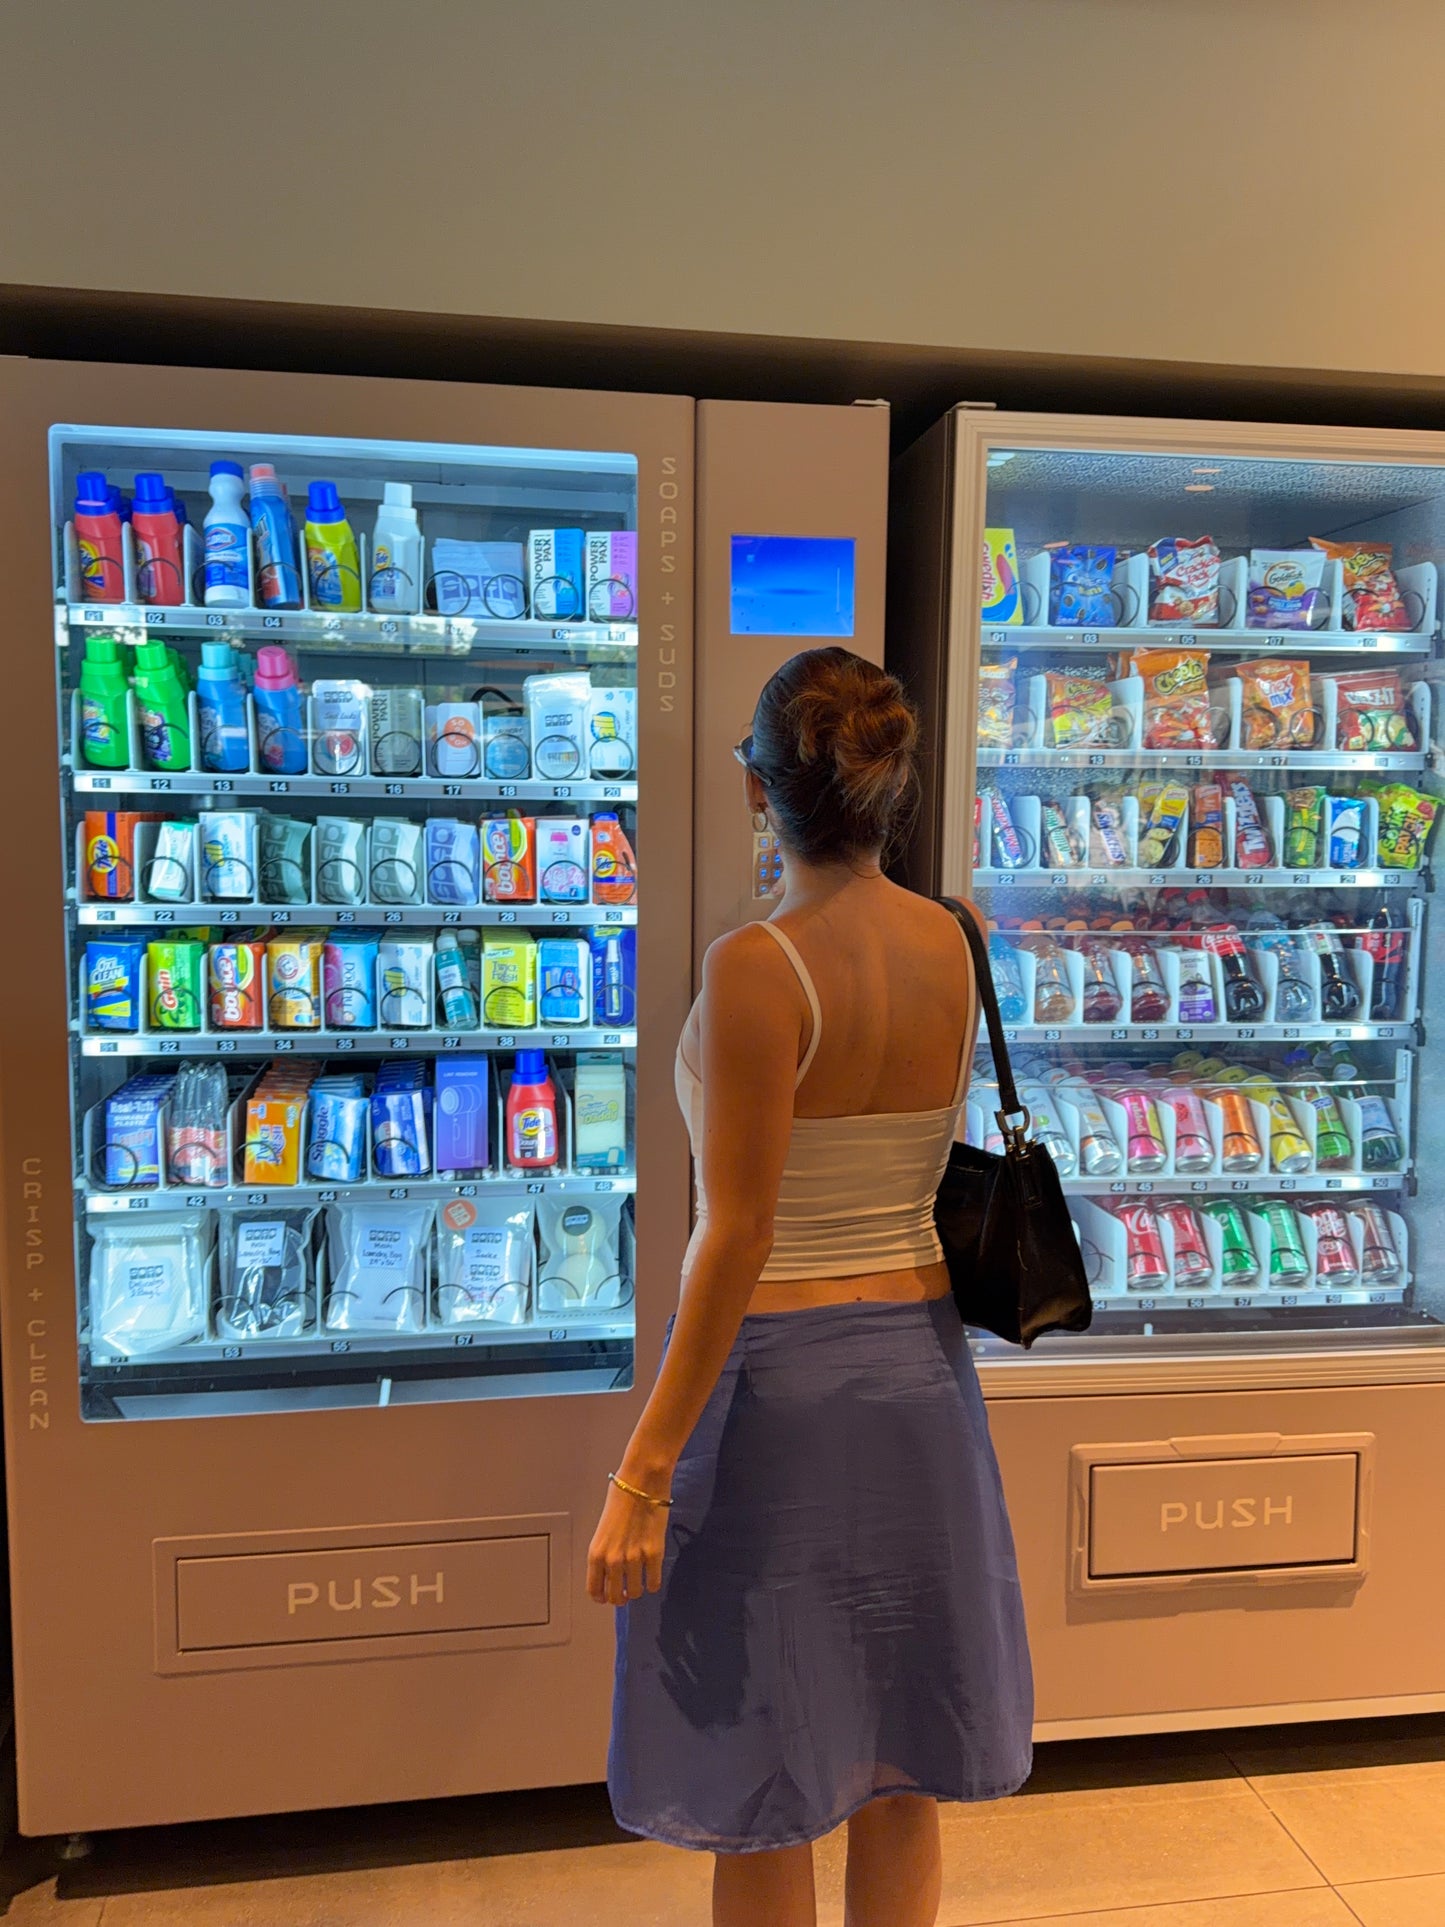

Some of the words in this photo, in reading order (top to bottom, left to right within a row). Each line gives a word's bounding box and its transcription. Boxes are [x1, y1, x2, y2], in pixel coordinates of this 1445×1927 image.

[659, 457, 678, 573] SOAPS
[543, 539, 551, 561] PAX
[599, 540, 607, 563] PAX
[534, 538, 543, 582] POWER
[590, 540, 598, 582] POWER
[661, 591, 674, 605] +
[147, 613, 162, 623] 02
[208, 615, 223, 625] 03
[265, 617, 280, 627] 04
[382, 622, 396, 632] 06
[555, 629, 568, 640] 09
[992, 633, 1005, 641] 01
[1084, 635, 1097, 643] 03
[1181, 636, 1194, 644] 05
[1269, 638, 1281, 646] 07
[658, 624, 676, 712] SUDS
[1256, 675, 1293, 696] Chex
[380, 697, 388, 722] PAX
[372, 697, 380, 736] POWER
[1006, 755, 1018, 763] 11
[1091, 756, 1104, 764] 13
[1189, 757, 1203, 765] 15
[1273, 757, 1286, 766] 17
[94, 779, 108, 788] 11
[153, 780, 168, 789] 12
[215, 781, 231, 791] 13
[271, 782, 287, 792] 14
[332, 783, 347, 793] 15
[387, 784, 402, 794] 16
[446, 786, 460, 795] 17
[501, 786, 516, 796] 18
[555, 787, 569, 797] 19
[605, 787, 620, 797] 20
[1381, 808, 1406, 849] SOUR
[1394, 812, 1418, 854] PATCH
[95, 841, 109, 868] Tide
[494, 831, 515, 894] bounce
[595, 857, 613, 872] Tide
[1000, 875, 1013, 883] 22
[1054, 875, 1066, 884] 23
[1092, 875, 1105, 883] 24
[1152, 875, 1164, 884] 25
[1250, 875, 1261, 883] 27
[157, 912, 172, 921] 22
[222, 912, 237, 921] 23
[273, 912, 289, 922] 24
[339, 912, 355, 921] 25
[387, 912, 401, 921] 26
[445, 912, 460, 921] 27
[501, 912, 516, 921] 28
[554, 912, 568, 921] 29
[607, 912, 621, 921] 30
[91, 967, 123, 981] CLEAN
[158, 971, 178, 1009] Gain
[220, 957, 241, 1021] bounce
[1003, 1031, 1016, 1040] 32
[1046, 1031, 1060, 1040] 33
[1113, 1031, 1126, 1039] 34
[1144, 1031, 1157, 1039] 35
[1178, 1030, 1191, 1038] 36
[1240, 1030, 1253, 1038] 37
[338, 1039, 353, 1049] 35
[392, 1038, 407, 1048] 36
[444, 1038, 459, 1047] 37
[500, 1037, 514, 1046] 38
[554, 1036, 568, 1045] 39
[606, 1035, 620, 1044] 40
[162, 1042, 177, 1051] 32
[220, 1041, 235, 1050] 33
[276, 1040, 292, 1050] 34
[522, 1116, 540, 1130] Tide
[310, 1106, 330, 1162] Snuggle
[255, 1124, 270, 1163] TWICE
[270, 1125, 285, 1165] FRESH
[529, 1184, 543, 1193] 47
[1112, 1183, 1124, 1191] 44
[1138, 1183, 1151, 1191] 45
[1193, 1182, 1206, 1190] 46
[1234, 1182, 1246, 1190] 47
[391, 1189, 407, 1199] 45
[461, 1186, 475, 1196] 46
[249, 1195, 265, 1204] 43
[320, 1192, 336, 1201] 44
[131, 1199, 146, 1208] 41
[189, 1197, 204, 1206] 42
[22, 1158, 45, 1269] CRISP
[28, 1288, 43, 1301] +
[1094, 1301, 1106, 1309] 54
[457, 1335, 472, 1344] 57
[27, 1320, 50, 1429] CLEAN
[1160, 1495, 1293, 1532] PUSH
[287, 1572, 444, 1614] PUSH
